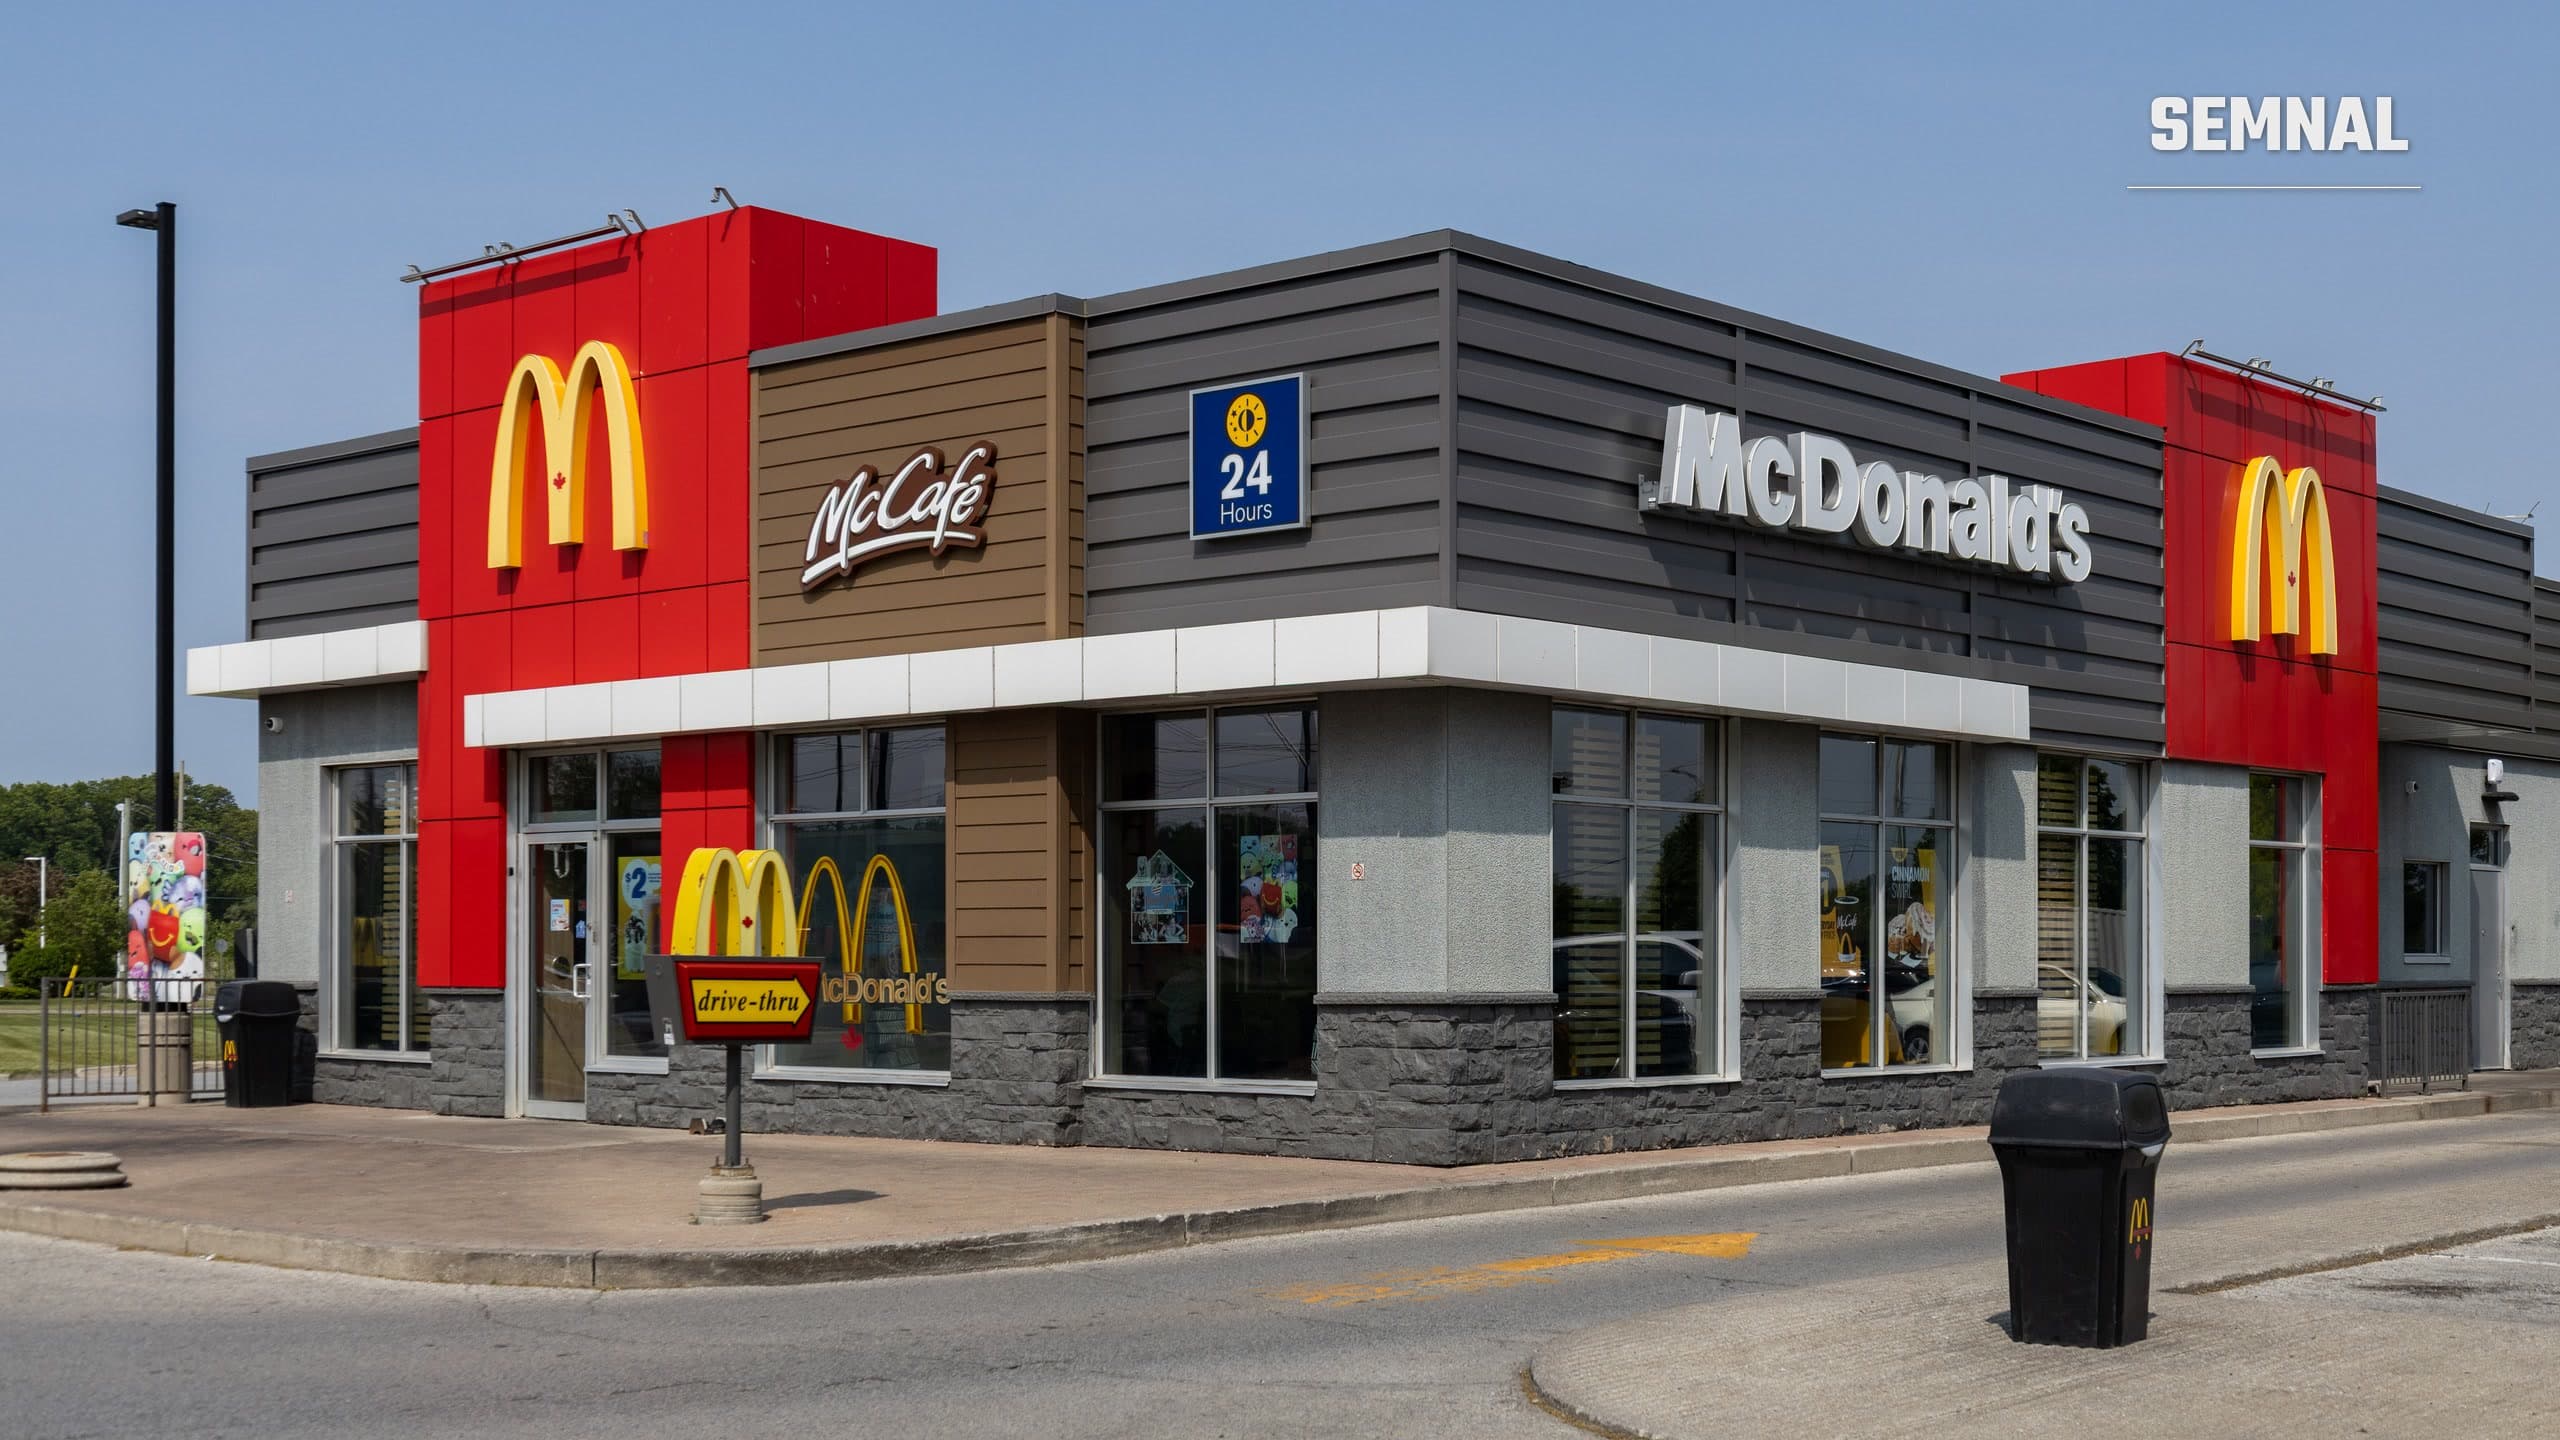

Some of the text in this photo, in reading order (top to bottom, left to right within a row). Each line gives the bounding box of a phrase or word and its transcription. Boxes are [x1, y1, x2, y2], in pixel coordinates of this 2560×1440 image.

[1221, 450, 1272, 500] 24
[1658, 404, 2093, 583] McDonald's
[802, 447, 987, 584] McCafé
[1220, 502, 1273, 525] Hours
[625, 867, 647, 899] $2
[1891, 865, 1930, 882] CINNAMON
[698, 989, 800, 1012] drive-thru
